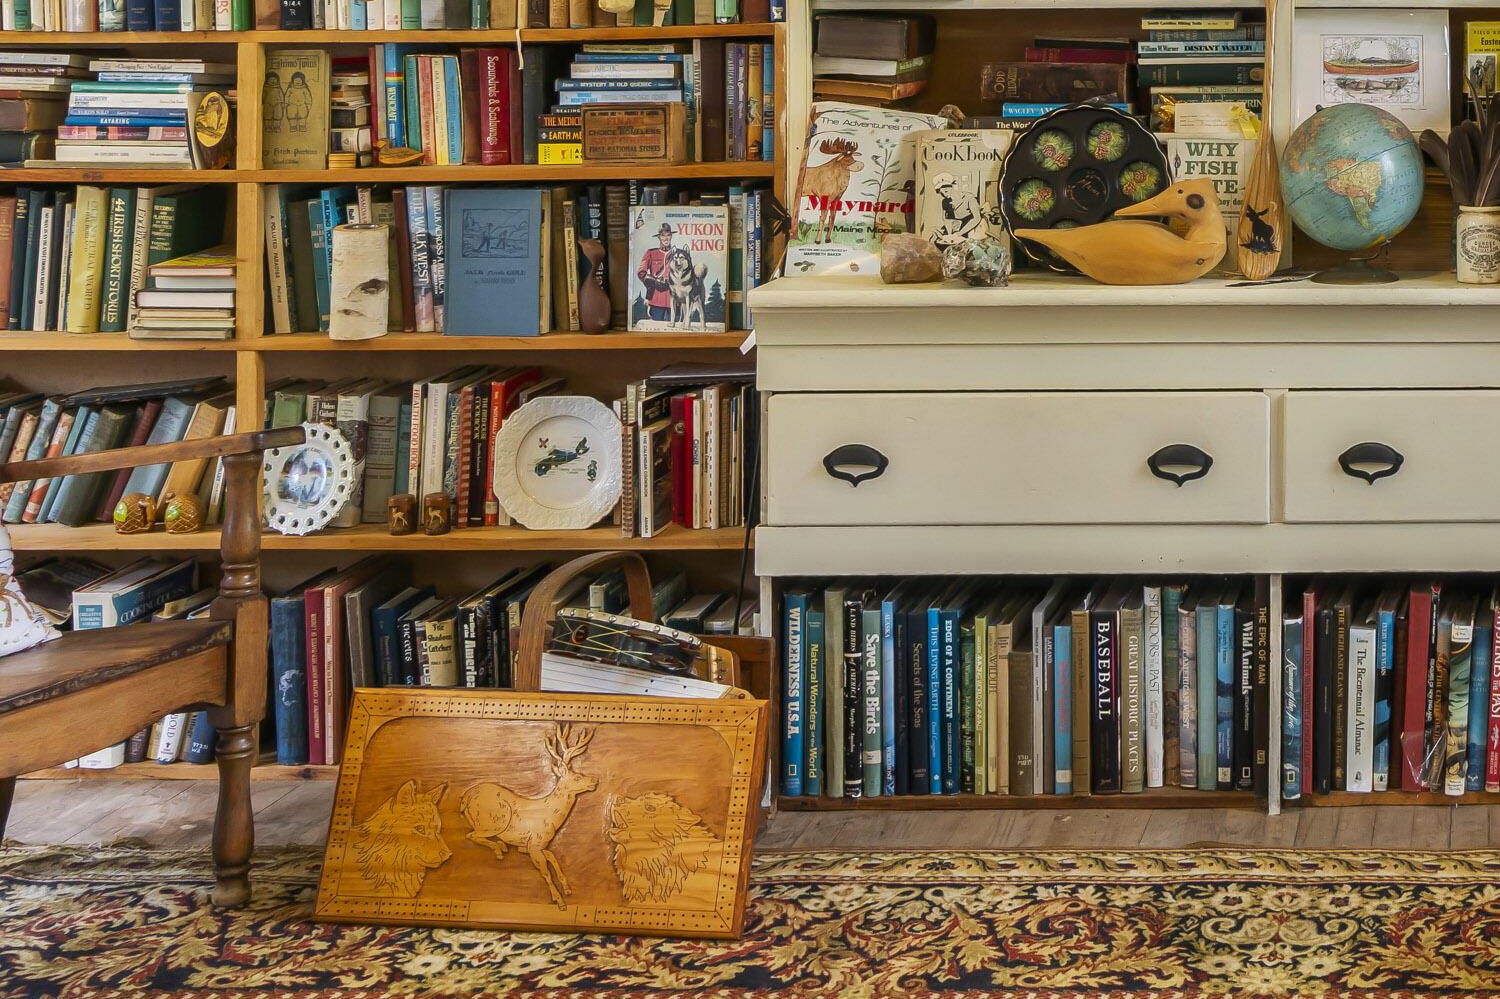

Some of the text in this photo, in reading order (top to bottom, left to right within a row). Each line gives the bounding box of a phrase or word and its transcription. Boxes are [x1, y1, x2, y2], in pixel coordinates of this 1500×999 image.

[487, 55, 499, 95] Scoundrels
[486, 107, 500, 145] Scalawags
[544, 117, 556, 126] THE
[549, 132, 570, 140] EARTH
[821, 117, 840, 125] The
[843, 120, 898, 130] Adventures
[1185, 161, 1238, 175] FISH
[1186, 142, 1237, 157] WHY
[433, 198, 441, 219] WALK
[804, 195, 914, 215] Maynard
[412, 191, 429, 283] THE WALK WEST
[435, 224, 443, 256] ACROSS
[676, 223, 724, 235] YUKON
[691, 239, 725, 251] KING
[107, 198, 125, 323] 44 IRISH SHORT STORIES
[410, 447, 418, 471] BOOK
[945, 620, 953, 643] EDGE
[945, 645, 953, 657] OF
[1149, 593, 1159, 695] SPLENDORS PAST
[1258, 607, 1267, 684] THE EPIC OF MAN
[787, 607, 801, 739] WILDERNESS U.S.A.
[930, 624, 939, 711] THIS LIVING EARTH
[1097, 622, 1110, 720] BASEBALL
[1241, 621, 1253, 695] Wild Animals
[849, 668, 857, 698] AMERICA
[865, 633, 880, 735] Save the Birds
[912, 643, 923, 728] Secrets of the Seas
[945, 667, 953, 719] CONTINENT
[1354, 649, 1367, 755] The Bicentennial Almanac
[809, 644, 819, 778] Natural Wonders World
[1128, 635, 1138, 772] GREAT HISTORIC PLACES
